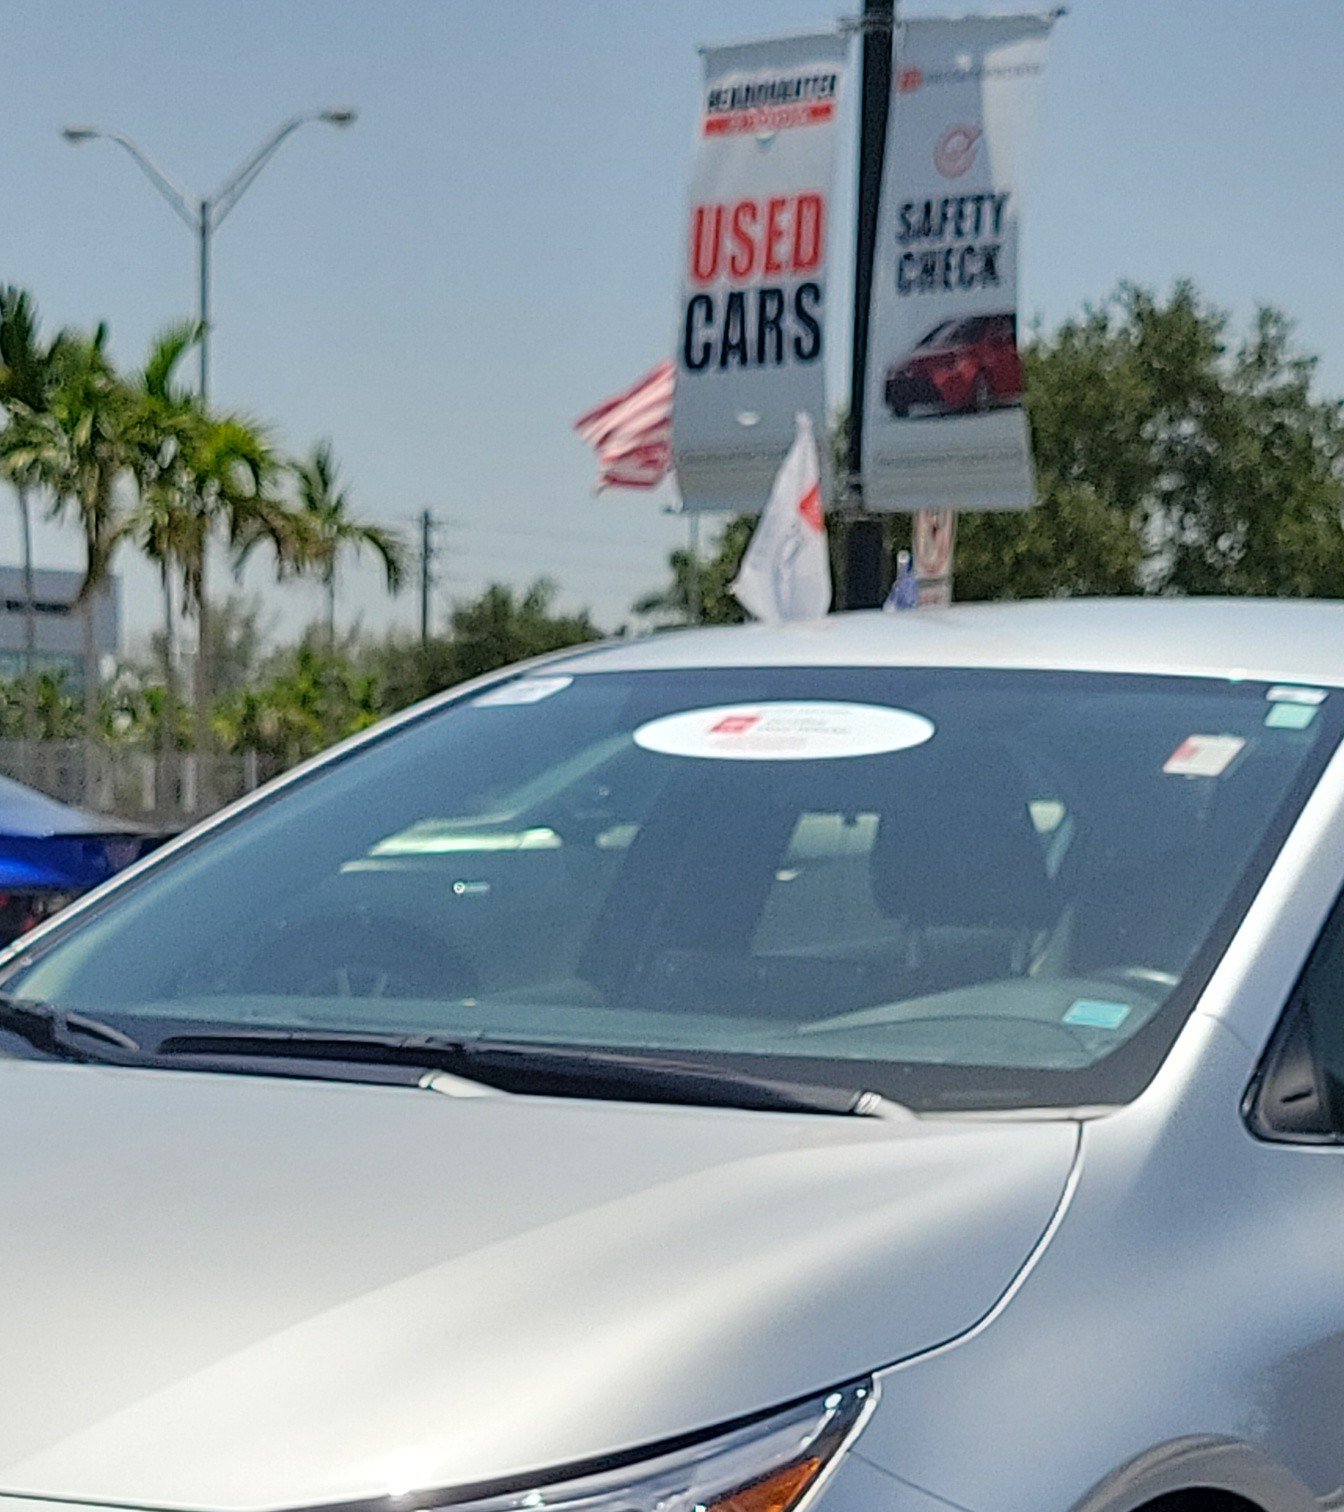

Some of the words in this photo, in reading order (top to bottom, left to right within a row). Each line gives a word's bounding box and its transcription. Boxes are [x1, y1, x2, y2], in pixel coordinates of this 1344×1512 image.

[692, 193, 822, 281] USED
[897, 192, 1011, 244] SAFETY
[897, 245, 1001, 295] CHECK
[685, 282, 822, 369] CARS
